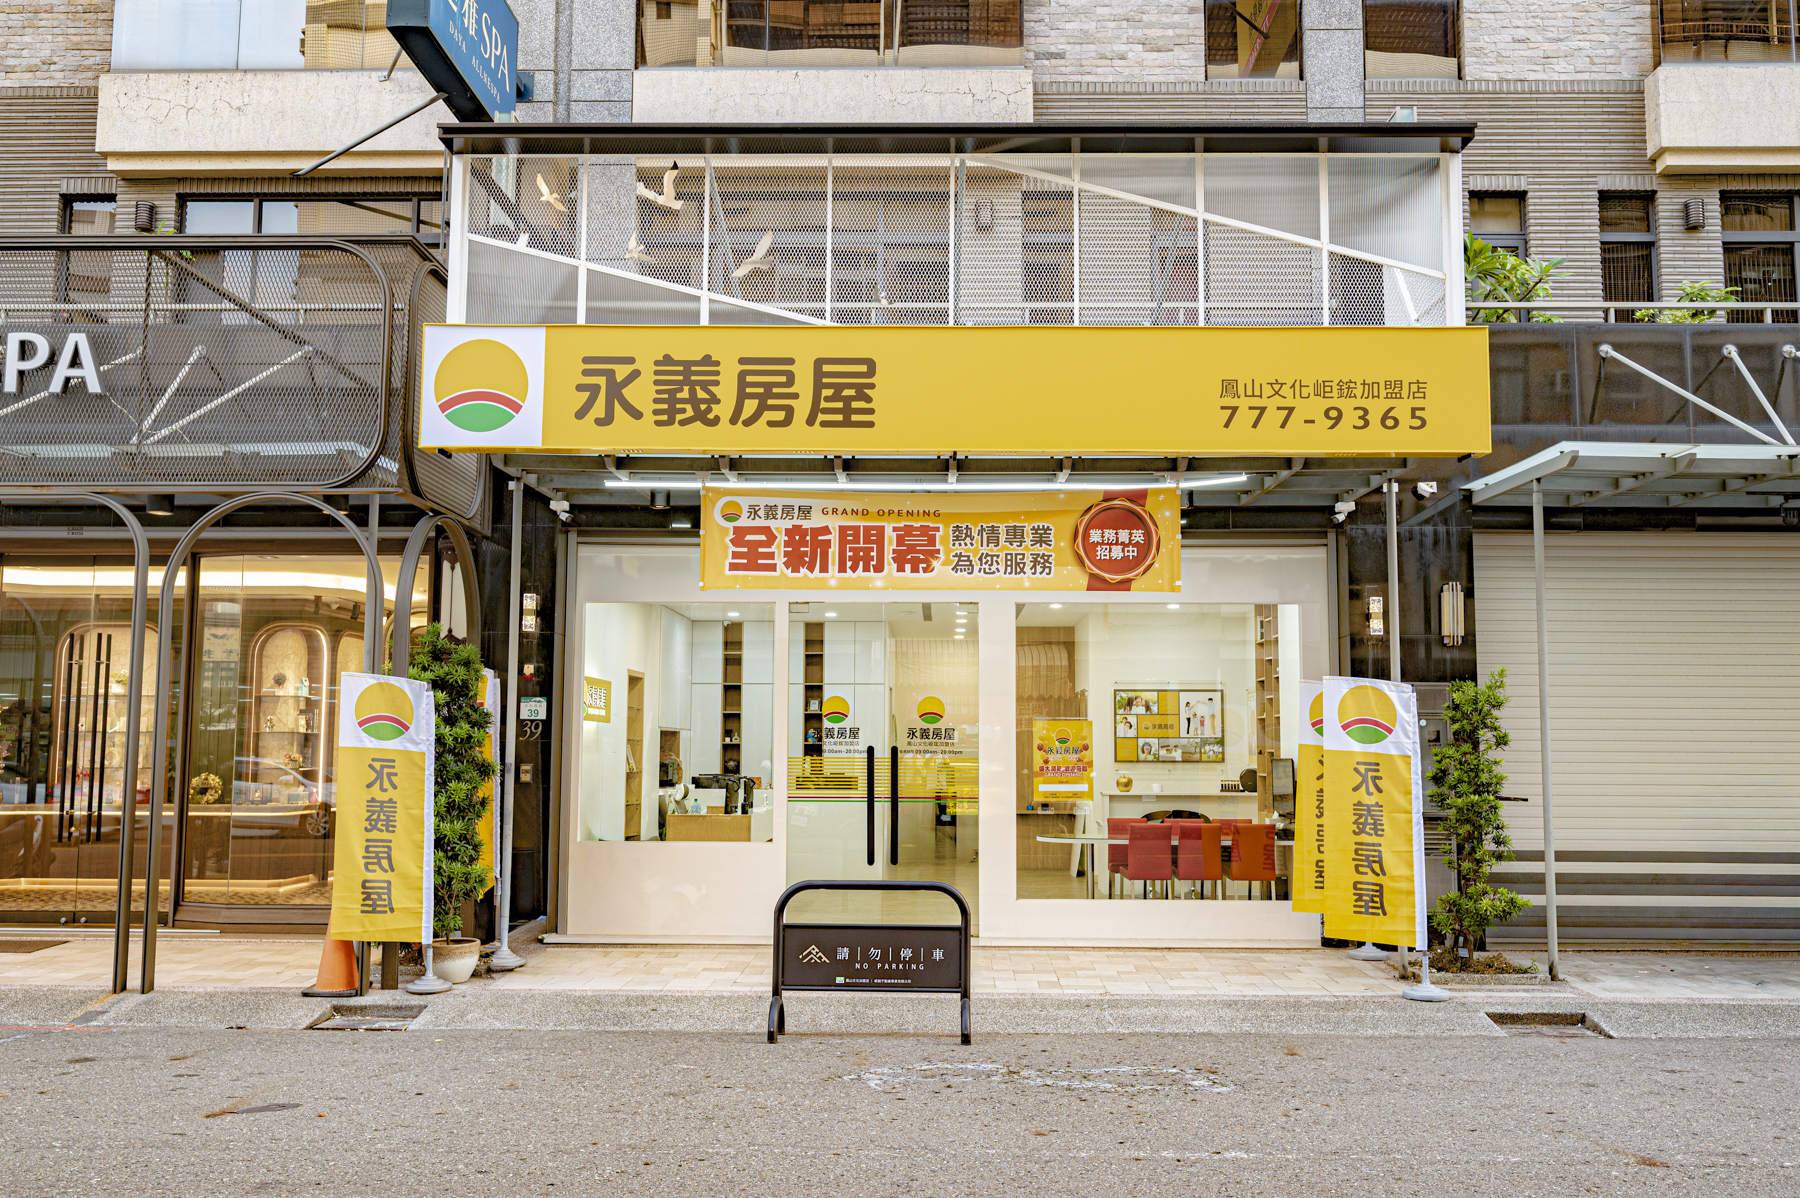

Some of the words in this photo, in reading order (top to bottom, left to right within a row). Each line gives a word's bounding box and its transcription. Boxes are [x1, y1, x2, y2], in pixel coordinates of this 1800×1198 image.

[449, 20, 467, 53] DAYA
[574, 353, 877, 428] 永義房屋
[1219, 378, 1428, 400] 鳳山文化岠鋐加盟店
[1219, 405, 1428, 431] 777-9365
[746, 503, 813, 521] 永義房屋
[821, 506, 870, 517] GRAND
[877, 508, 942, 518] OPENING
[950, 524, 1054, 549] 熱情專業
[1089, 528, 1145, 545] 業務菁英
[727, 523, 942, 575] 全新開幕
[1095, 545, 1139, 561] 招募中
[950, 552, 1054, 576] 為您服務
[527, 708, 540, 718] 39
[519, 720, 543, 740] 39
[906, 728, 956, 740] 永義房屋
